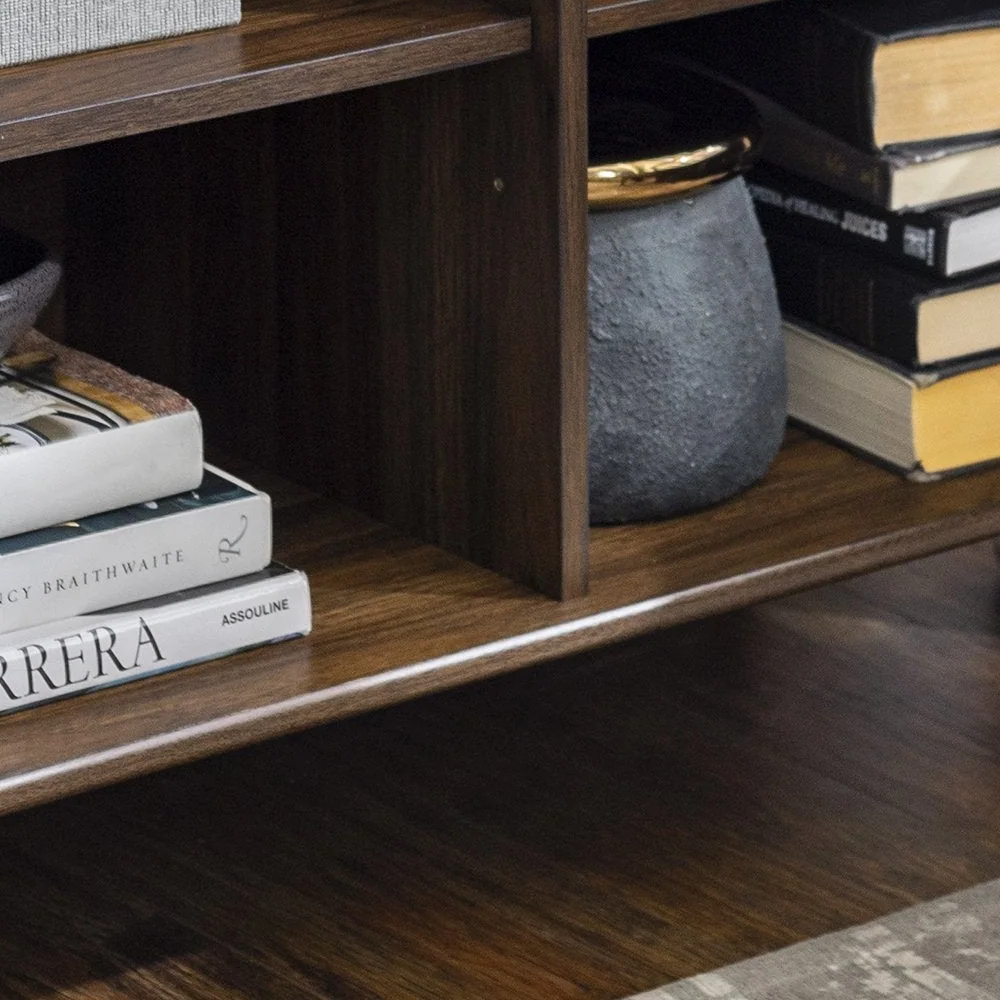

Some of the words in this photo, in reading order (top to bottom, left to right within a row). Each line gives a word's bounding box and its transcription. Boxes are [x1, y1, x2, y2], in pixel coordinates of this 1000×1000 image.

[0, 585, 32, 604] CY
[43, 549, 185, 595] BRAITHWAITE
[221, 598, 290, 626] ASSOULINE
